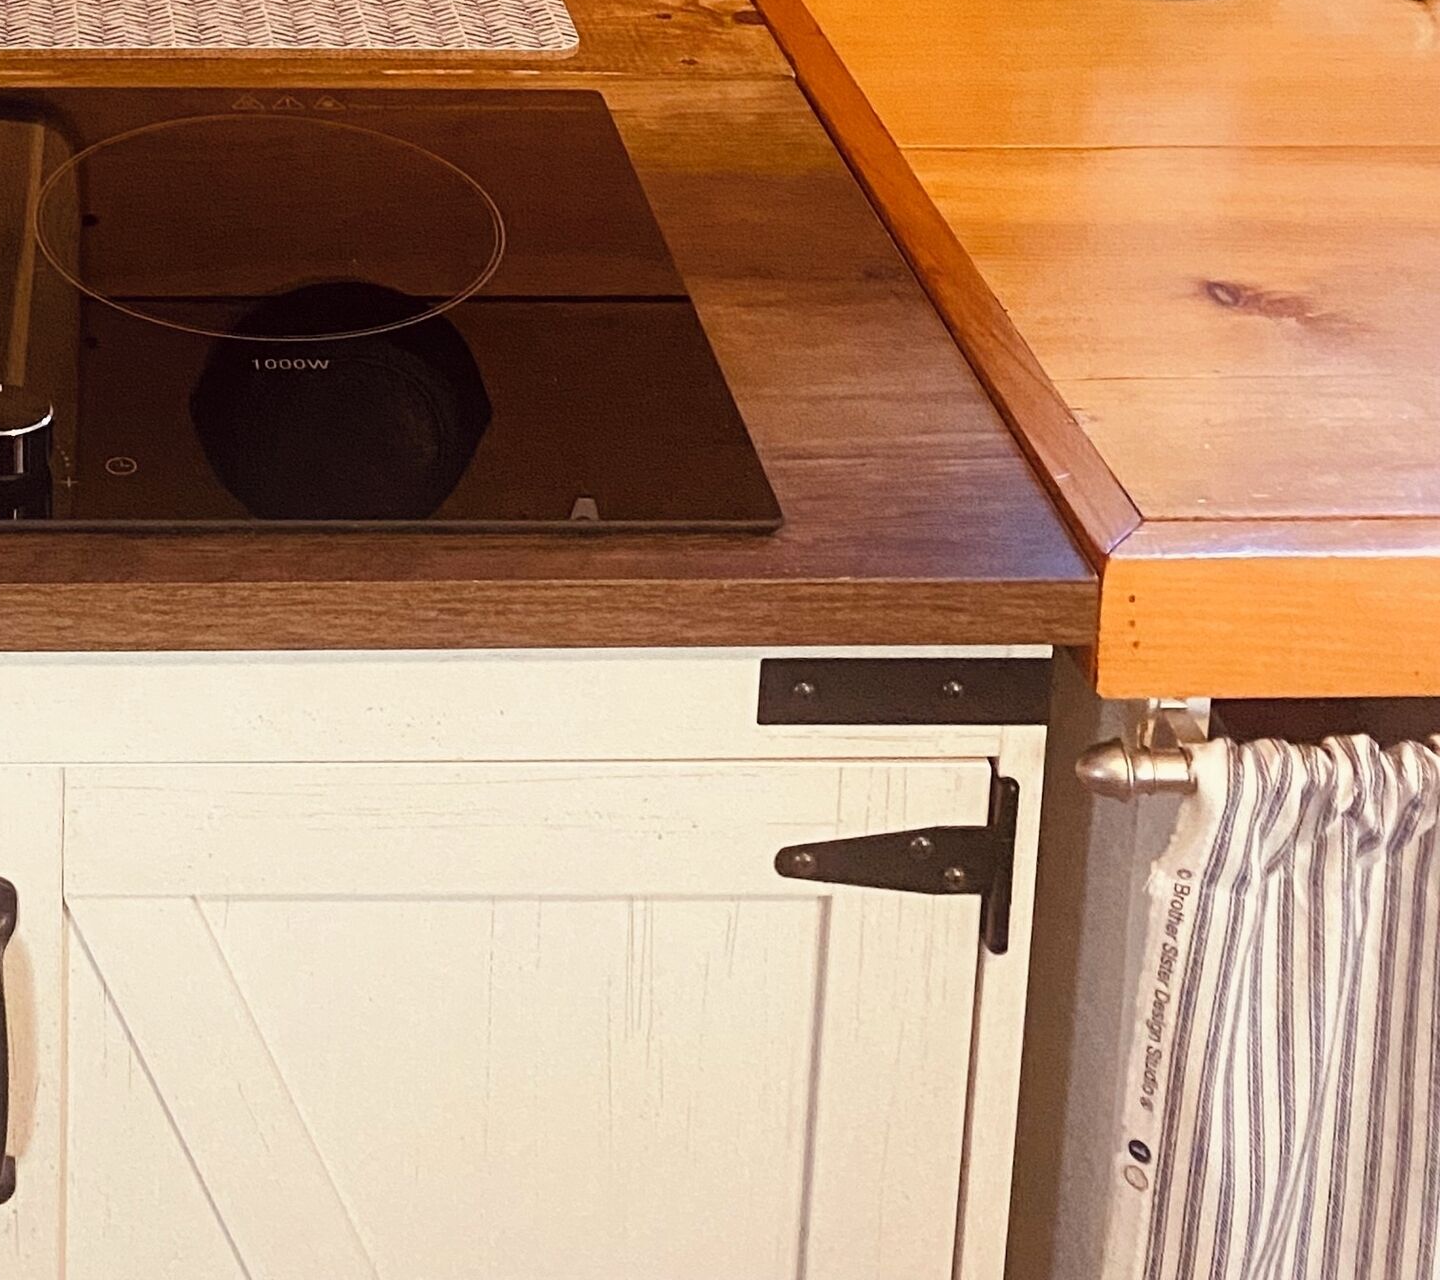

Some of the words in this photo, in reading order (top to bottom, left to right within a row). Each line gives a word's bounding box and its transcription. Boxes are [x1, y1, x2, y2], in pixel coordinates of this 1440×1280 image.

[252, 358, 329, 371] 1000W
[1165, 882, 1192, 943] Brother
[1157, 942, 1179, 988] Sister
[1145, 988, 1171, 1043] Design
[1143, 1045, 1162, 1096] Studio
